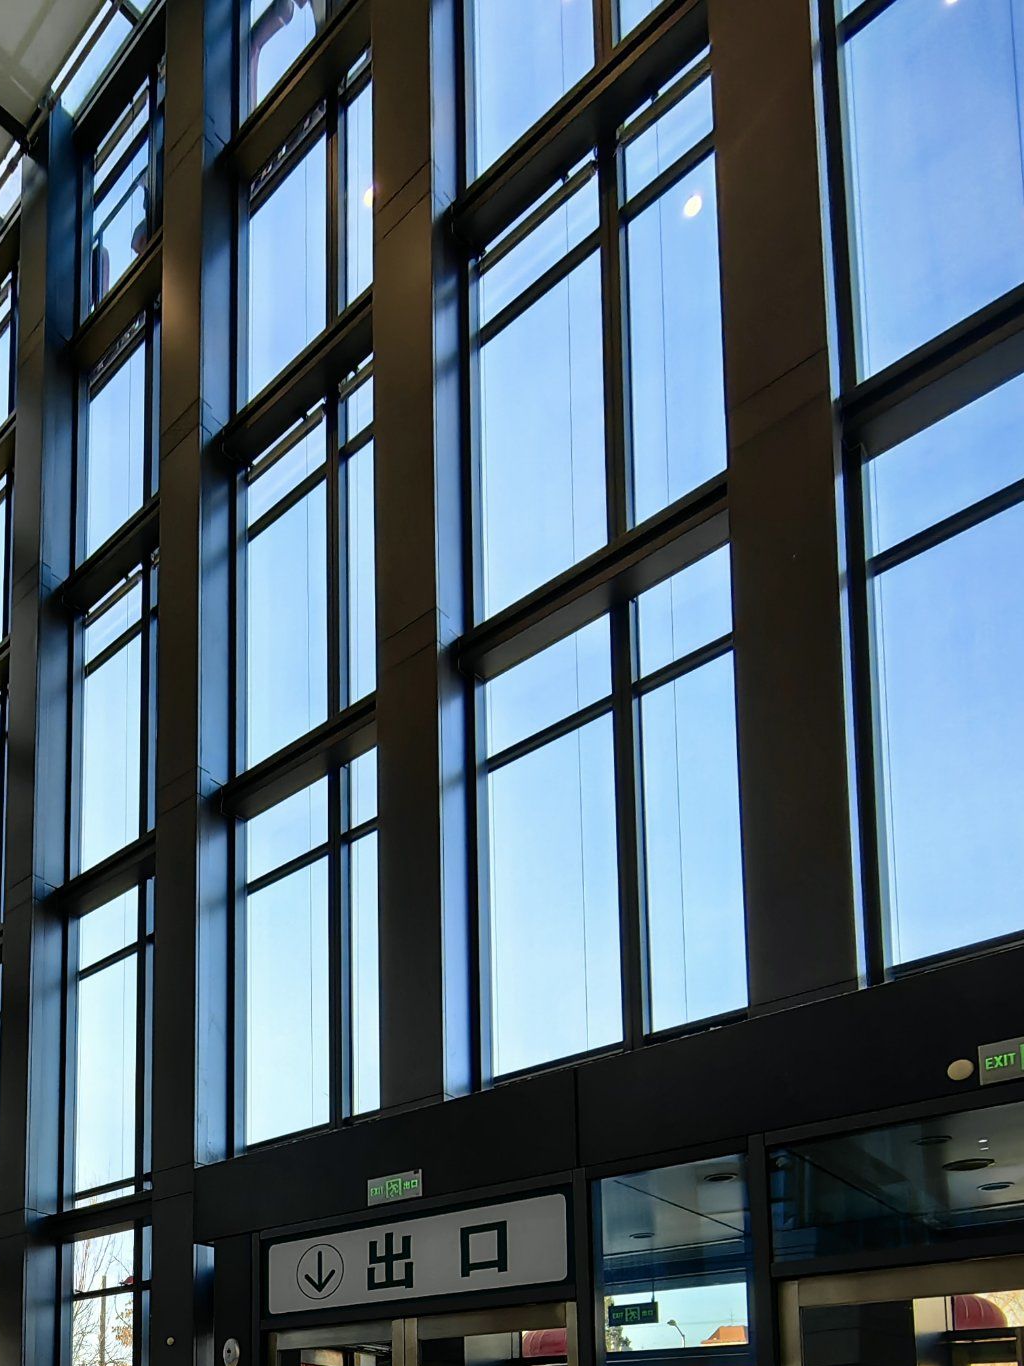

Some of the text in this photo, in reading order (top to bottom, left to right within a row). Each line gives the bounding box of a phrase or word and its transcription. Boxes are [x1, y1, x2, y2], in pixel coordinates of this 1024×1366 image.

[985, 1052, 1017, 1071] EXIT
[370, 1179, 418, 1197] EXIT 出口
[367, 1220, 508, 1291] 出口
